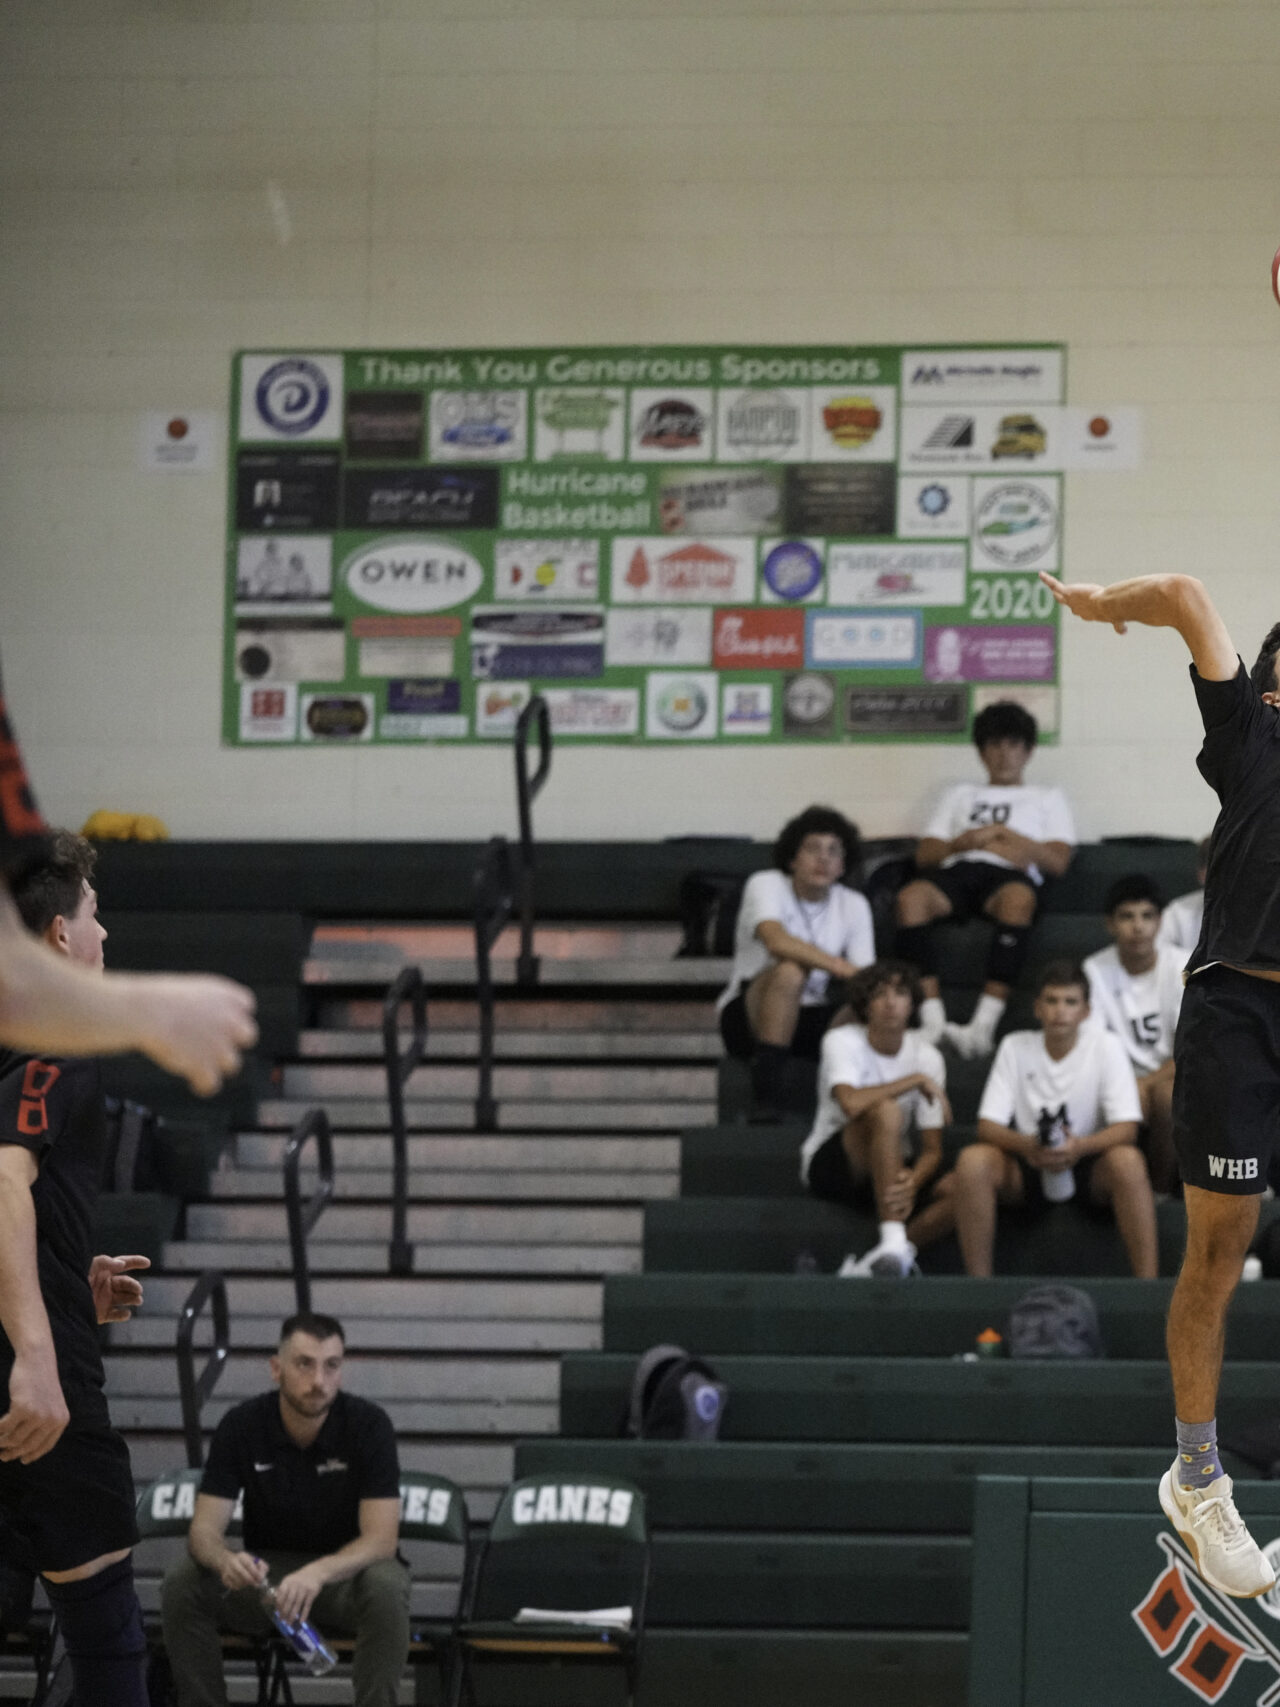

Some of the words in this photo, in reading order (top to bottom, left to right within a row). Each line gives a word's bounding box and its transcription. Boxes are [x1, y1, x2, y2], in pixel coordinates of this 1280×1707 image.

[360, 355, 463, 385] Thank
[472, 355, 539, 383] You
[546, 353, 713, 383] Generous
[720, 352, 881, 384] Sponsors
[507, 471, 648, 496] Hurricane
[502, 501, 651, 530] Basketball
[360, 559, 467, 585] OWEN
[971, 578, 1056, 619] 2020
[17, 1059, 61, 1134] 8
[1208, 1154, 1259, 1180] WHB
[513, 1484, 634, 1528] CANES
